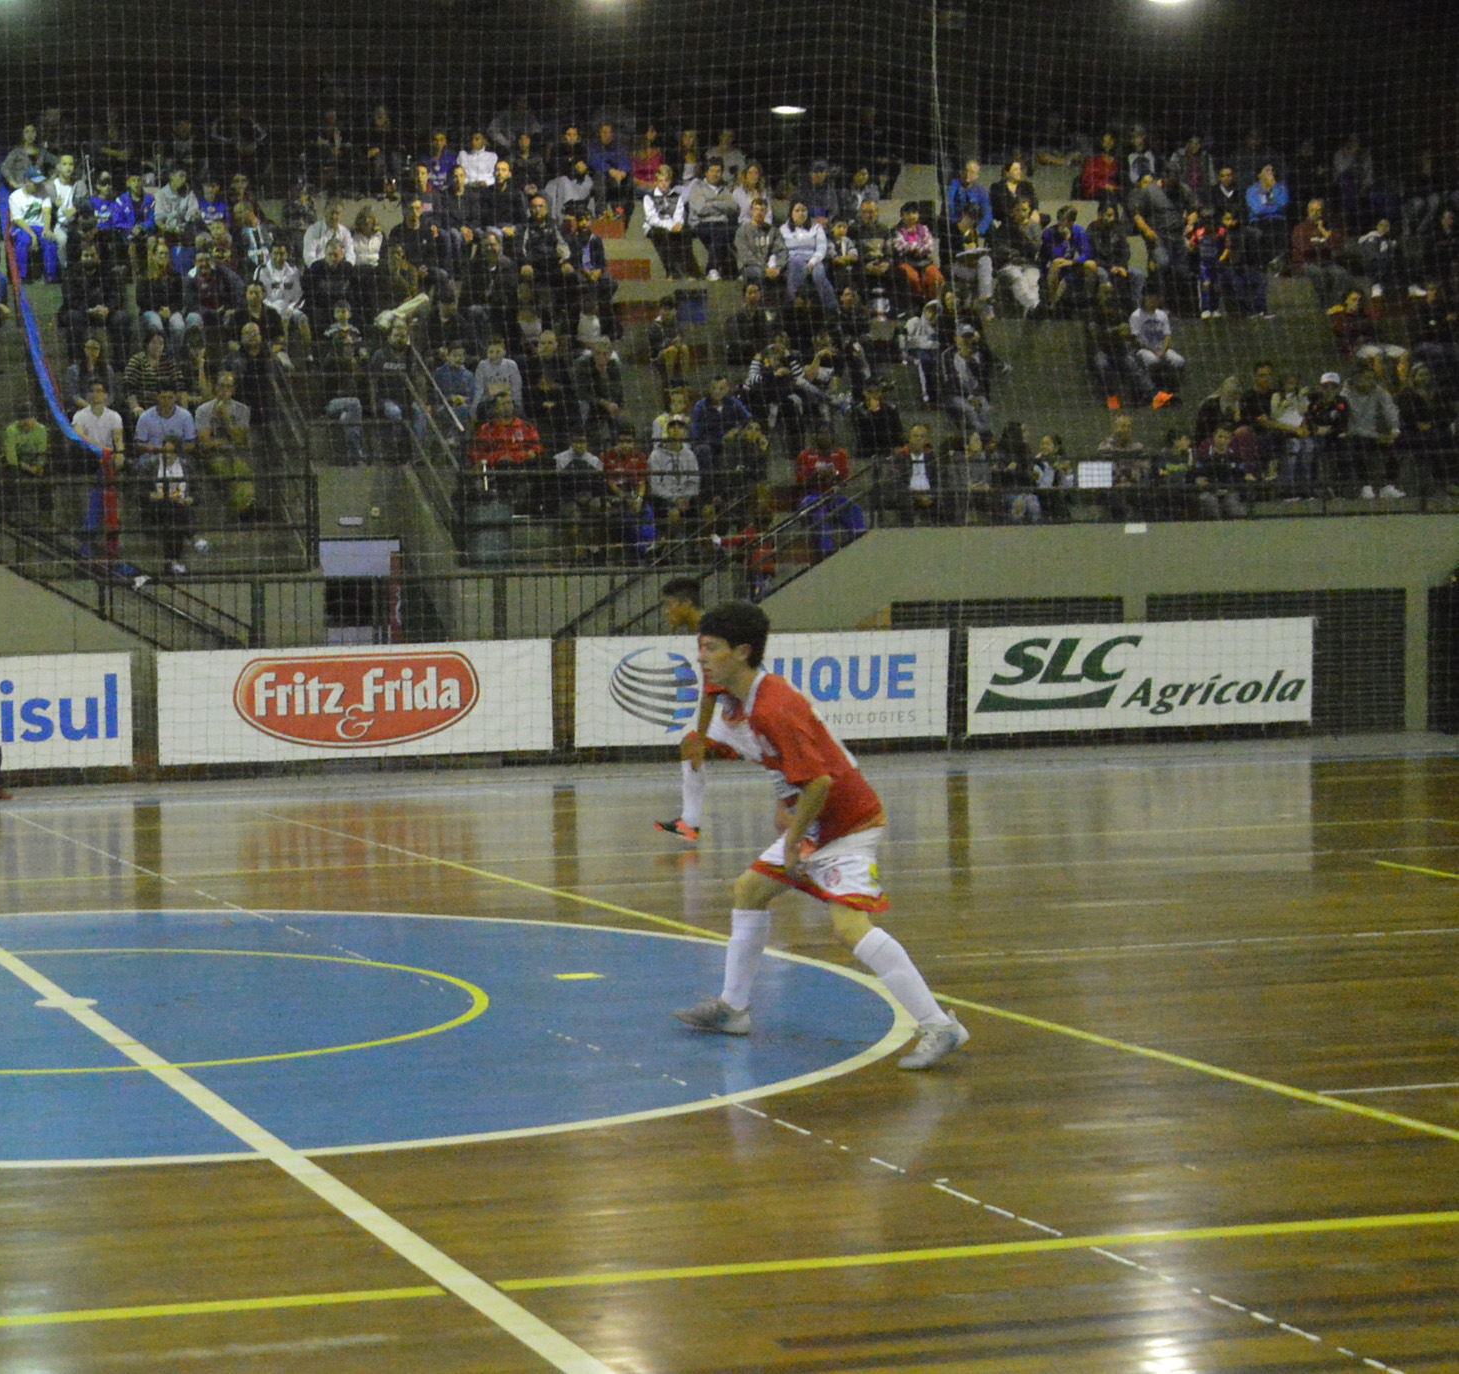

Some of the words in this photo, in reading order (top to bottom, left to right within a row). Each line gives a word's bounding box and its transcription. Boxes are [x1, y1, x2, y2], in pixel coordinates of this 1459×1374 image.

[990, 635, 1143, 686] SLC
[254, 671, 346, 717] Fritz
[335, 704, 374, 740] &
[362, 666, 461, 713] Frida
